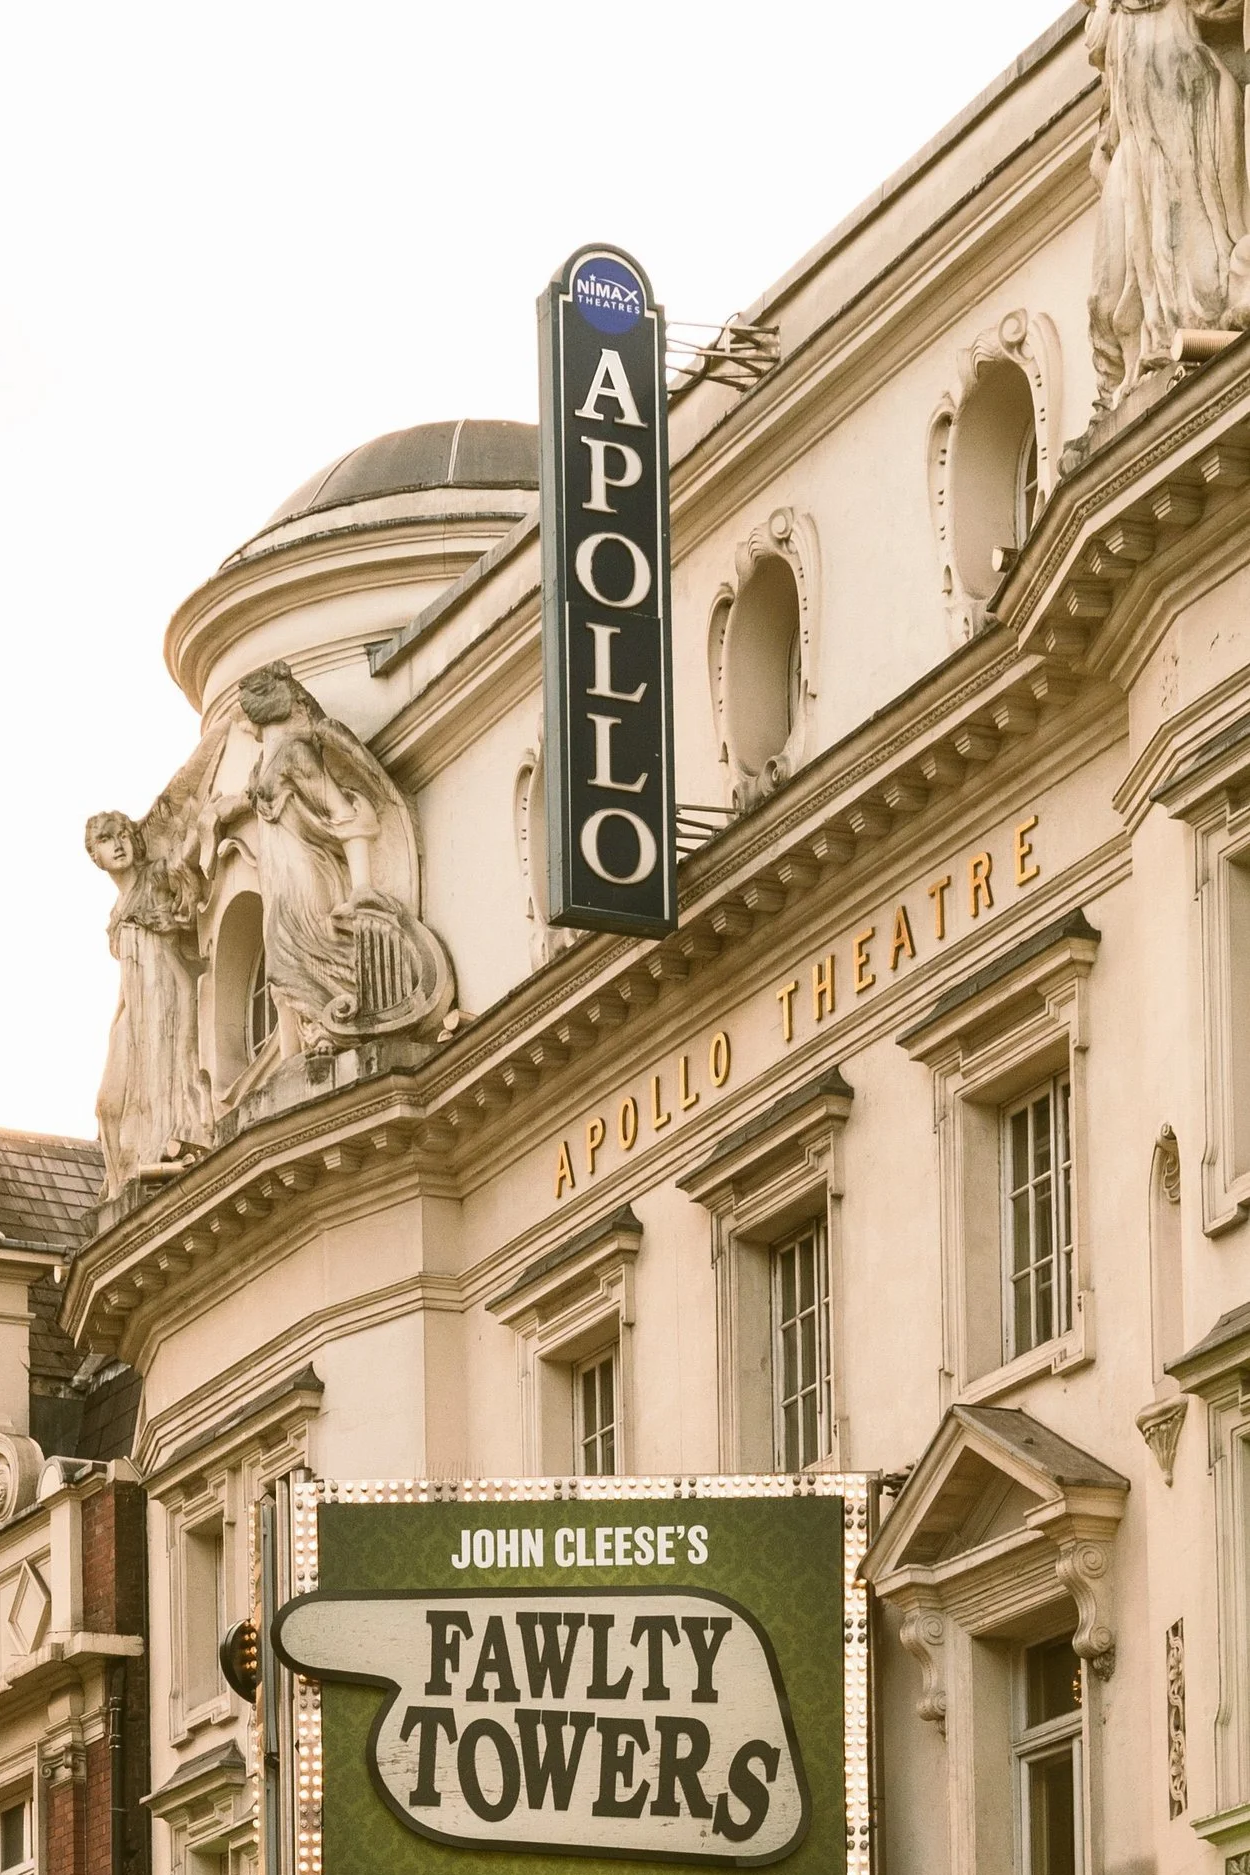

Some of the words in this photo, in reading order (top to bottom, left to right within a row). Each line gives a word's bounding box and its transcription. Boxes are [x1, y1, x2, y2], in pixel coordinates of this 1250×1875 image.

[578, 294, 640, 315] THEATRES
[574, 348, 657, 885] APOLLO
[554, 1029, 732, 1199] APOLLO
[776, 815, 1042, 1043] THEATRE
[451, 1528, 544, 1570] JOHN
[425, 1609, 733, 1704] FAWLTY
[400, 1706, 781, 1842] TOWERS
